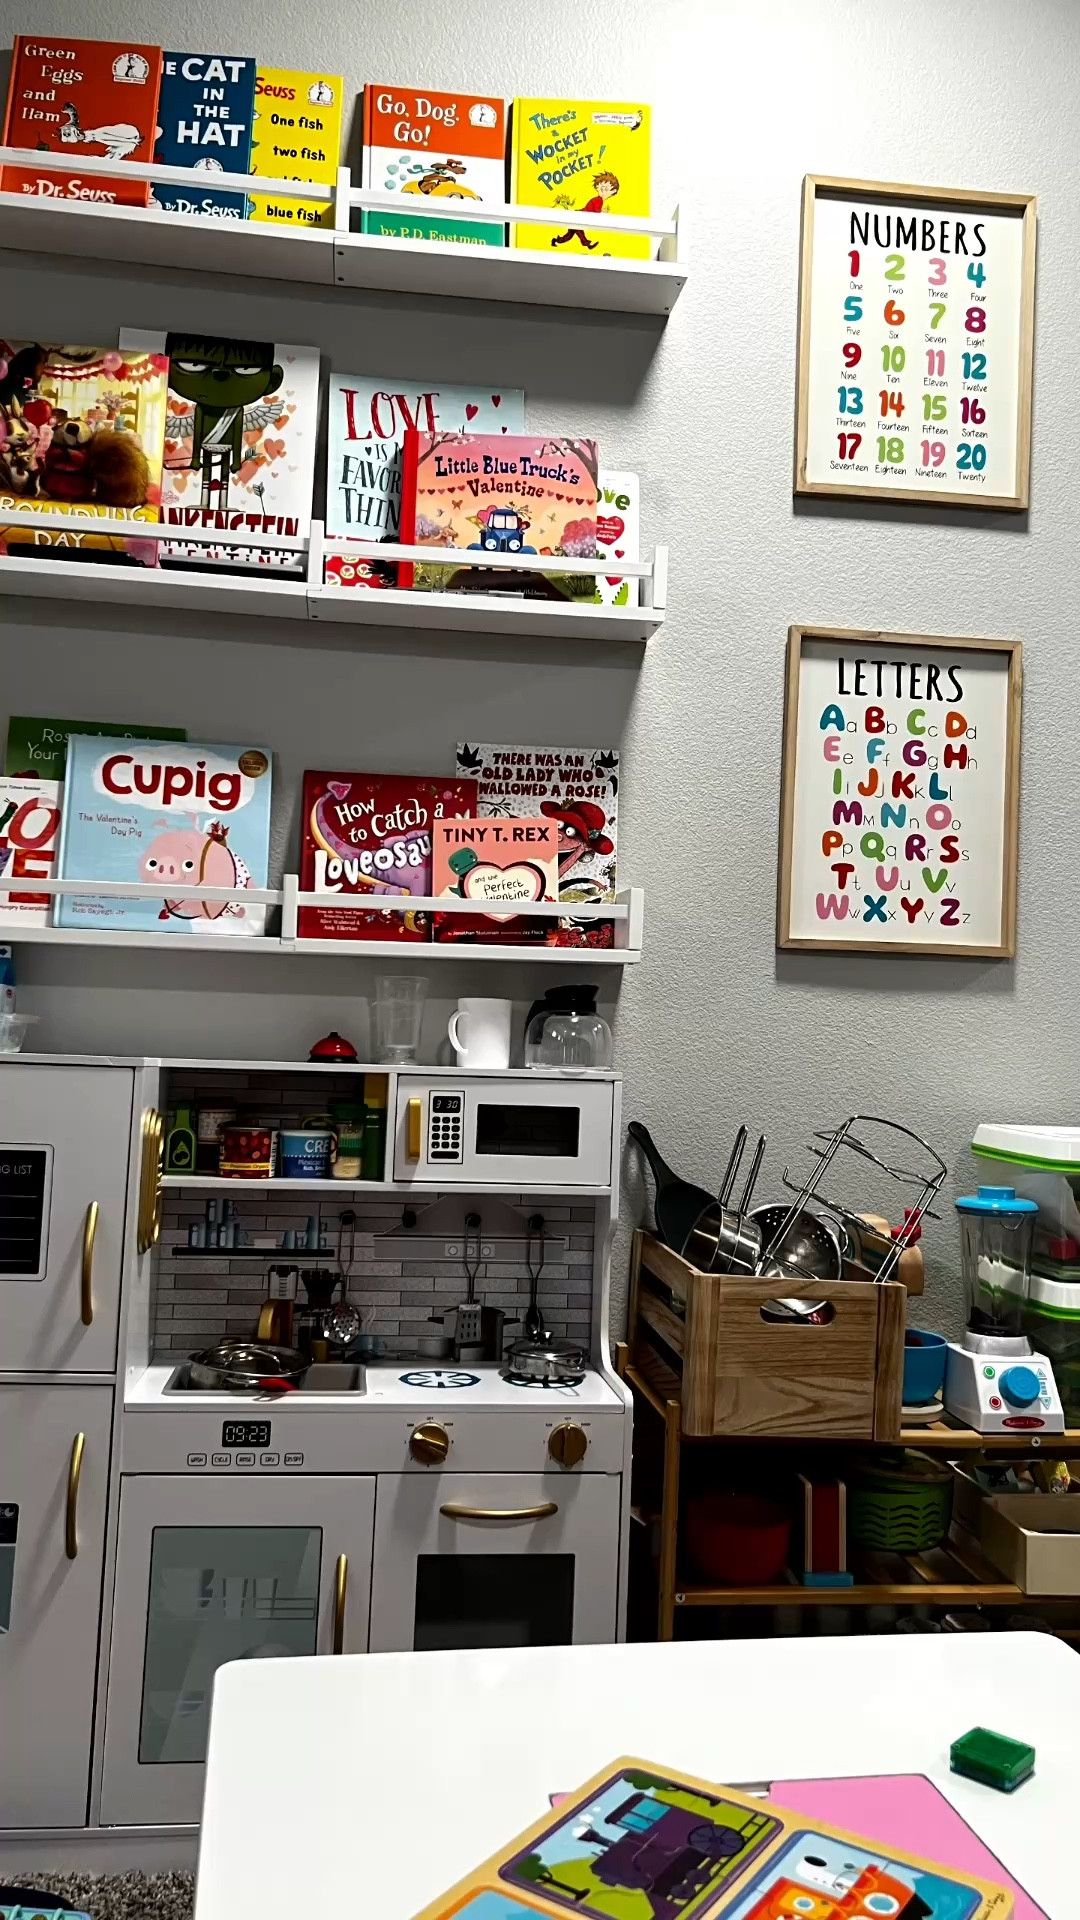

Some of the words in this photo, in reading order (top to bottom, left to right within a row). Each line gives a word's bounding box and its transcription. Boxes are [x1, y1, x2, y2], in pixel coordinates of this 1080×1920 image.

[25, 44, 76, 60] Green
[41, 65, 84, 85] Eggs
[181, 58, 246, 83] CAT
[23, 89, 56, 101] and
[203, 88, 224, 100] IN
[255, 77, 296, 100] Seuss
[22, 107, 61, 122] Ham
[193, 104, 230, 119] THE
[271, 113, 295, 127] One
[298, 116, 324, 131] fish
[415, 98, 460, 127] Dog.
[529, 110, 577, 131] There's
[177, 121, 246, 147] HAT
[394, 121, 431, 146] Go!
[551, 129, 560, 138] a
[273, 145, 298, 157] two
[301, 147, 326, 162] fish
[525, 127, 588, 165] WOCKET
[557, 155, 565, 164] in
[568, 149, 579, 159] my
[22, 183, 36, 193] By
[36, 179, 65, 198] Dr.
[67, 180, 117, 203] Seuss
[165, 202, 176, 211] By
[176, 199, 199, 215] Dr.
[202, 199, 241, 219] Seuss
[266, 204, 293, 218] blue
[297, 208, 322, 222] fish
[381, 225, 396, 237] by
[429, 231, 487, 246] Eastman
[849, 210, 987, 258] NUMBERS
[848, 250, 860, 278] 1
[885, 254, 906, 281] 2
[928, 258, 947, 285] 3
[967, 262, 986, 288] 4
[850, 281, 863, 290] One
[888, 285, 903, 294] Two
[928, 289, 948, 298] Three
[971, 292, 986, 302] Four
[843, 296, 863, 322] 5
[884, 300, 906, 326] 6
[929, 303, 946, 329] 7
[964, 306, 986, 333] 8
[847, 326, 860, 336] Five
[925, 334, 946, 344] Seven
[966, 337, 985, 348] Eight
[842, 342, 862, 368] 9
[881, 345, 906, 372] 10
[926, 349, 945, 377] 11
[961, 352, 987, 380] 12
[841, 371, 856, 380] Nine
[886, 374, 900, 383] Ten
[924, 377, 948, 387] Eleven
[962, 382, 988, 392] Twelve
[339, 388, 440, 440] LOVE
[838, 386, 864, 415] 13
[879, 390, 905, 418] 14
[922, 394, 947, 421] 15
[960, 397, 986, 425] 16
[836, 418, 866, 428] Thirteen
[878, 421, 909, 432] Fourteen
[922, 425, 948, 435] Fifteen
[374, 443, 388, 462] IS
[837, 432, 862, 460] 17
[876, 436, 904, 464] 18
[920, 440, 945, 467] 19
[956, 443, 987, 472] 20
[340, 454, 401, 494] FAVOR
[435, 456, 479, 477] Little
[483, 455, 517, 475] Blue
[519, 456, 580, 485] Truck's
[830, 460, 868, 472] Seventeen
[875, 464, 906, 475] Eighteen
[915, 467, 947, 478] Nineteen
[958, 470, 986, 483] Twenty
[466, 478, 545, 497] Valentine
[338, 486, 401, 530] THIN
[597, 486, 631, 511] ve
[34, 530, 86, 548] DAY
[838, 657, 964, 703] LETTERS
[27, 741, 60, 760] Your
[492, 752, 532, 765] THERE
[535, 754, 562, 766] WAS
[564, 755, 584, 767] AN
[102, 755, 241, 811] Cupig
[482, 767, 513, 780] OLD
[516, 767, 555, 782] LADY
[559, 769, 593, 783] WHO
[479, 782, 547, 796] WALLOWED
[551, 785, 561, 797] A
[565, 784, 606, 799] ROSE!
[78, 813, 94, 822] The
[96, 814, 138, 824] Valentine's
[334, 799, 375, 826] How
[348, 827, 368, 843] to
[371, 798, 427, 837] Catch
[433, 802, 444, 818] a
[111, 826, 127, 837] Day
[128, 827, 143, 838] Pig
[443, 828, 488, 842] TINY
[492, 828, 508, 842] T.
[512, 827, 550, 842] REX
[315, 836, 431, 893] Loveosau
[14, 1165, 32, 1175] LIST
[225, 1425, 268, 1442] 09:23
